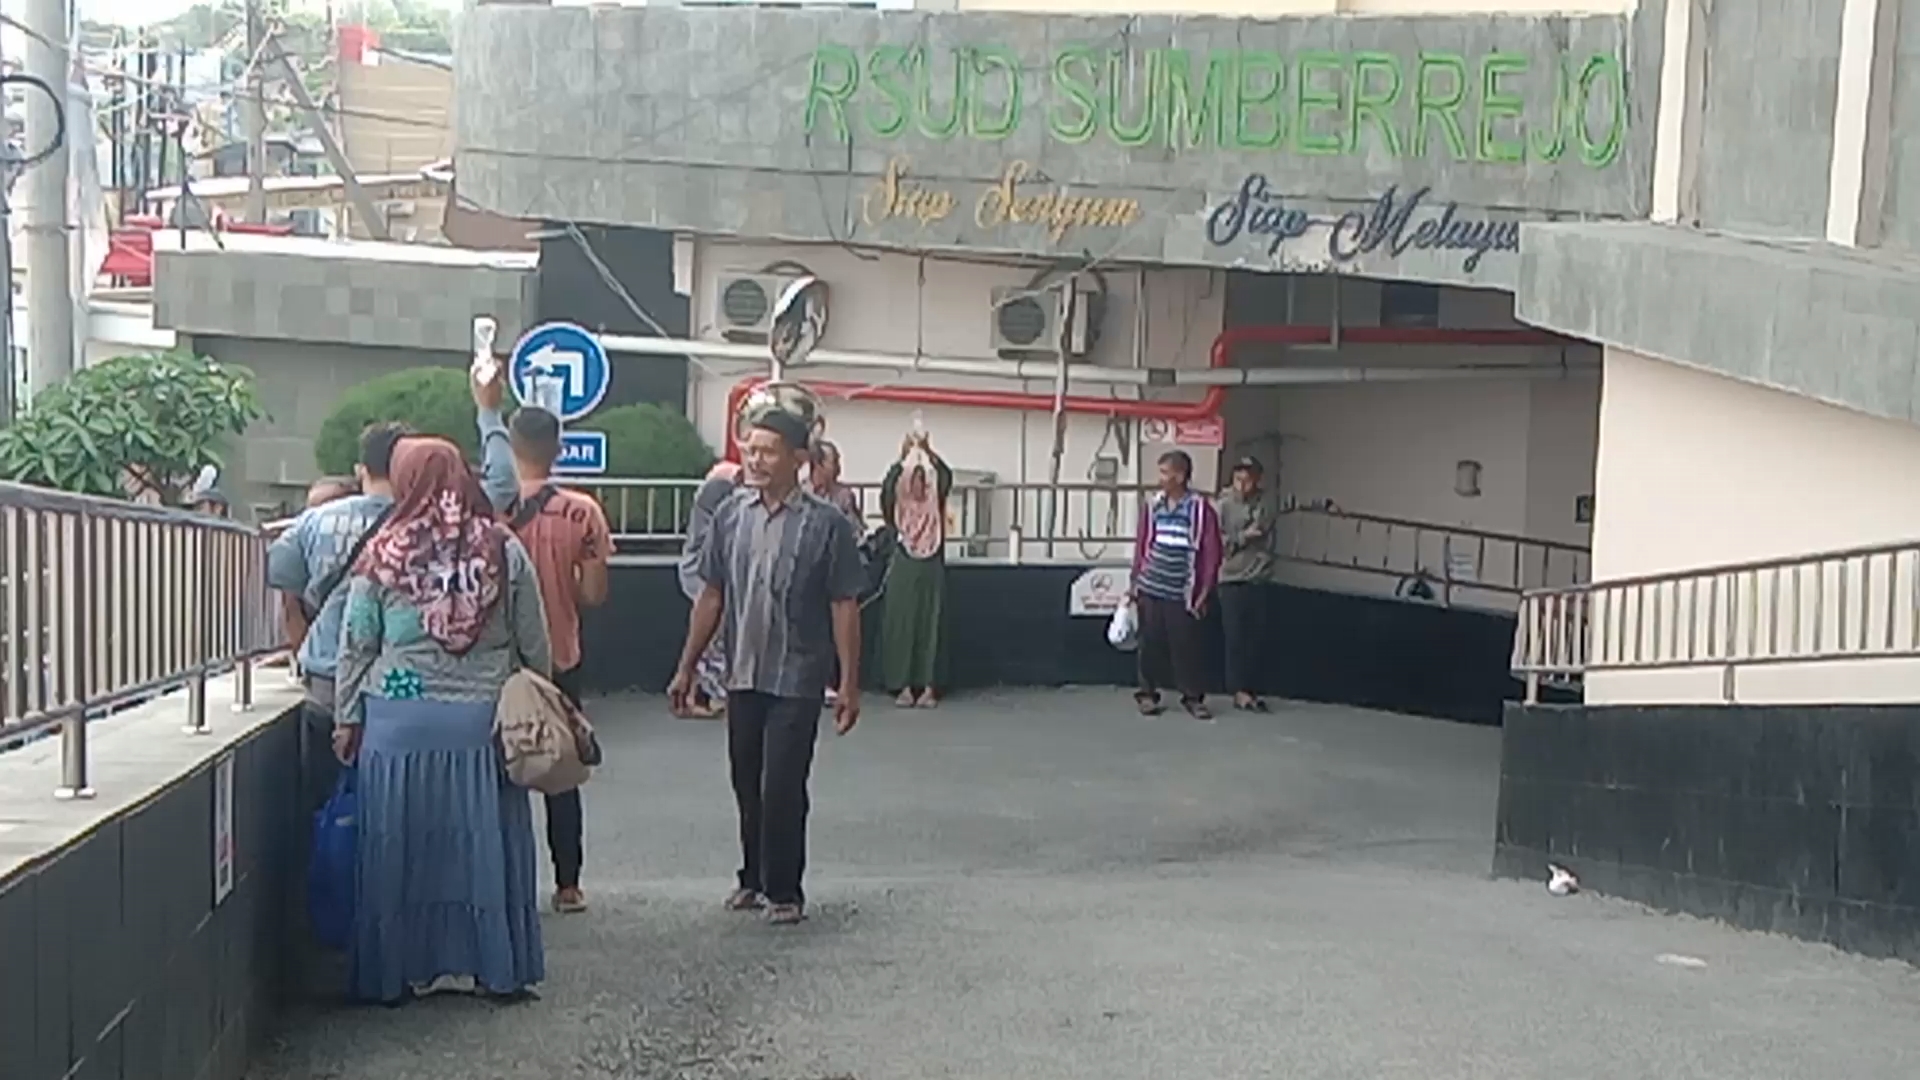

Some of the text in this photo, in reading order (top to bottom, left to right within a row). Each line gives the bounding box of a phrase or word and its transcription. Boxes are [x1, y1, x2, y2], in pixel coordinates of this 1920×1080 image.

[805, 43, 1624, 169] RSUD SUMBERREJO
[863, 153, 957, 228] Siap
[1206, 173, 1310, 256] Siap
